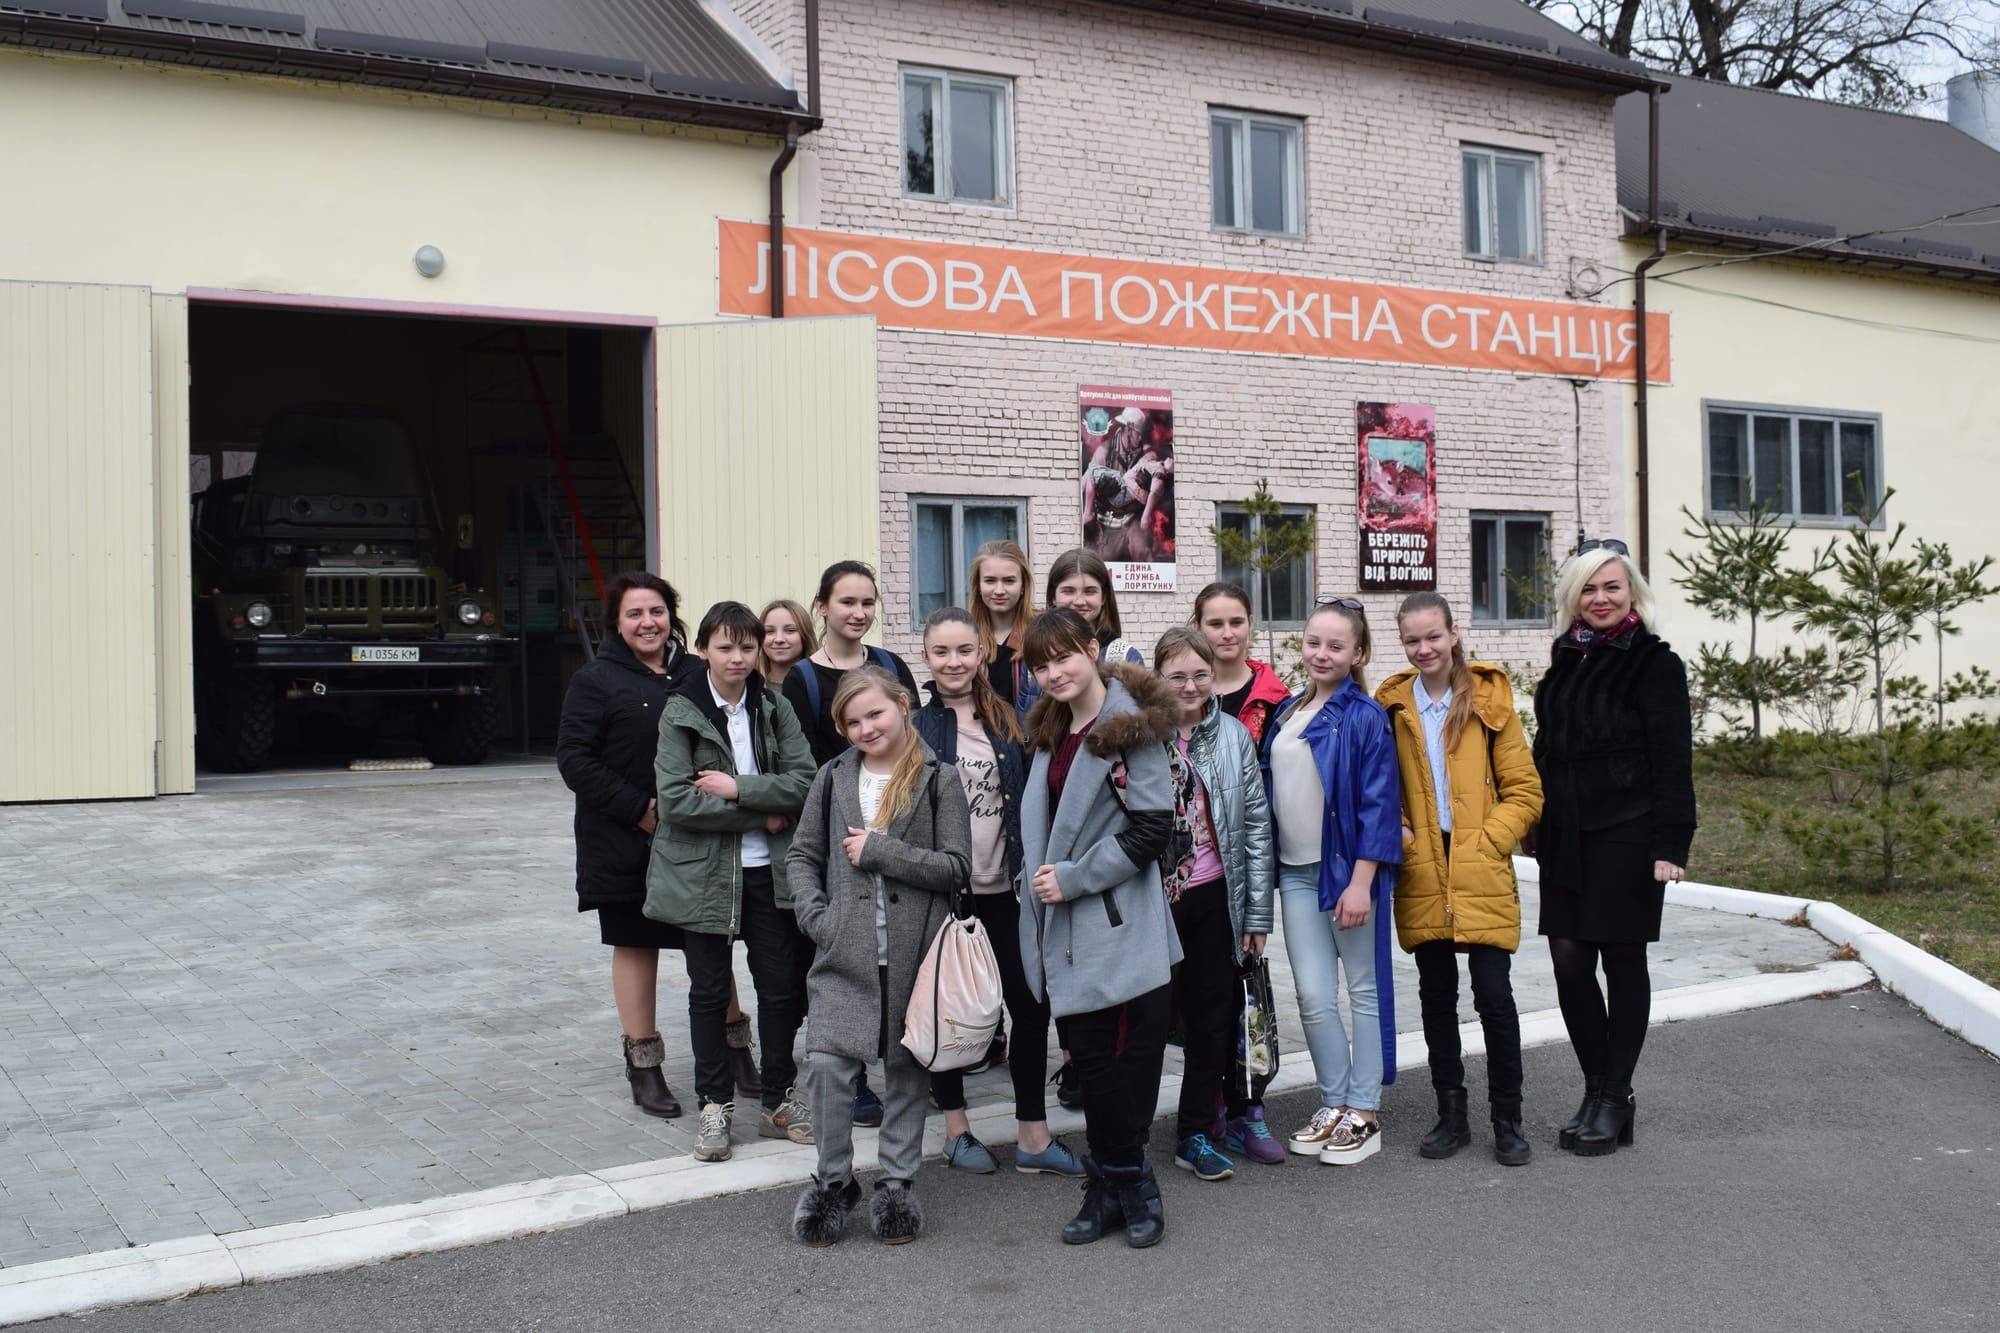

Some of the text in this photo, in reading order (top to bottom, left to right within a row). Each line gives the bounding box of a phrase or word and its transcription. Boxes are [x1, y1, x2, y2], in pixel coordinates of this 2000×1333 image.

[748, 241, 1638, 371] ЛІСОВА ПОЖЕЖНА СТАНЦІЯ
[1368, 532, 1428, 549] БЕРЕЖІТЬ
[1372, 549, 1425, 566] ПРИРОДУ
[1125, 573, 1160, 581] СЛУЖБА
[1364, 565, 1433, 582] ВІД ВОГНЮ!
[1125, 582, 1173, 590] ПОРЯТУНКУ
[375, 649, 399, 660] 0356
[401, 649, 417, 660] KM
